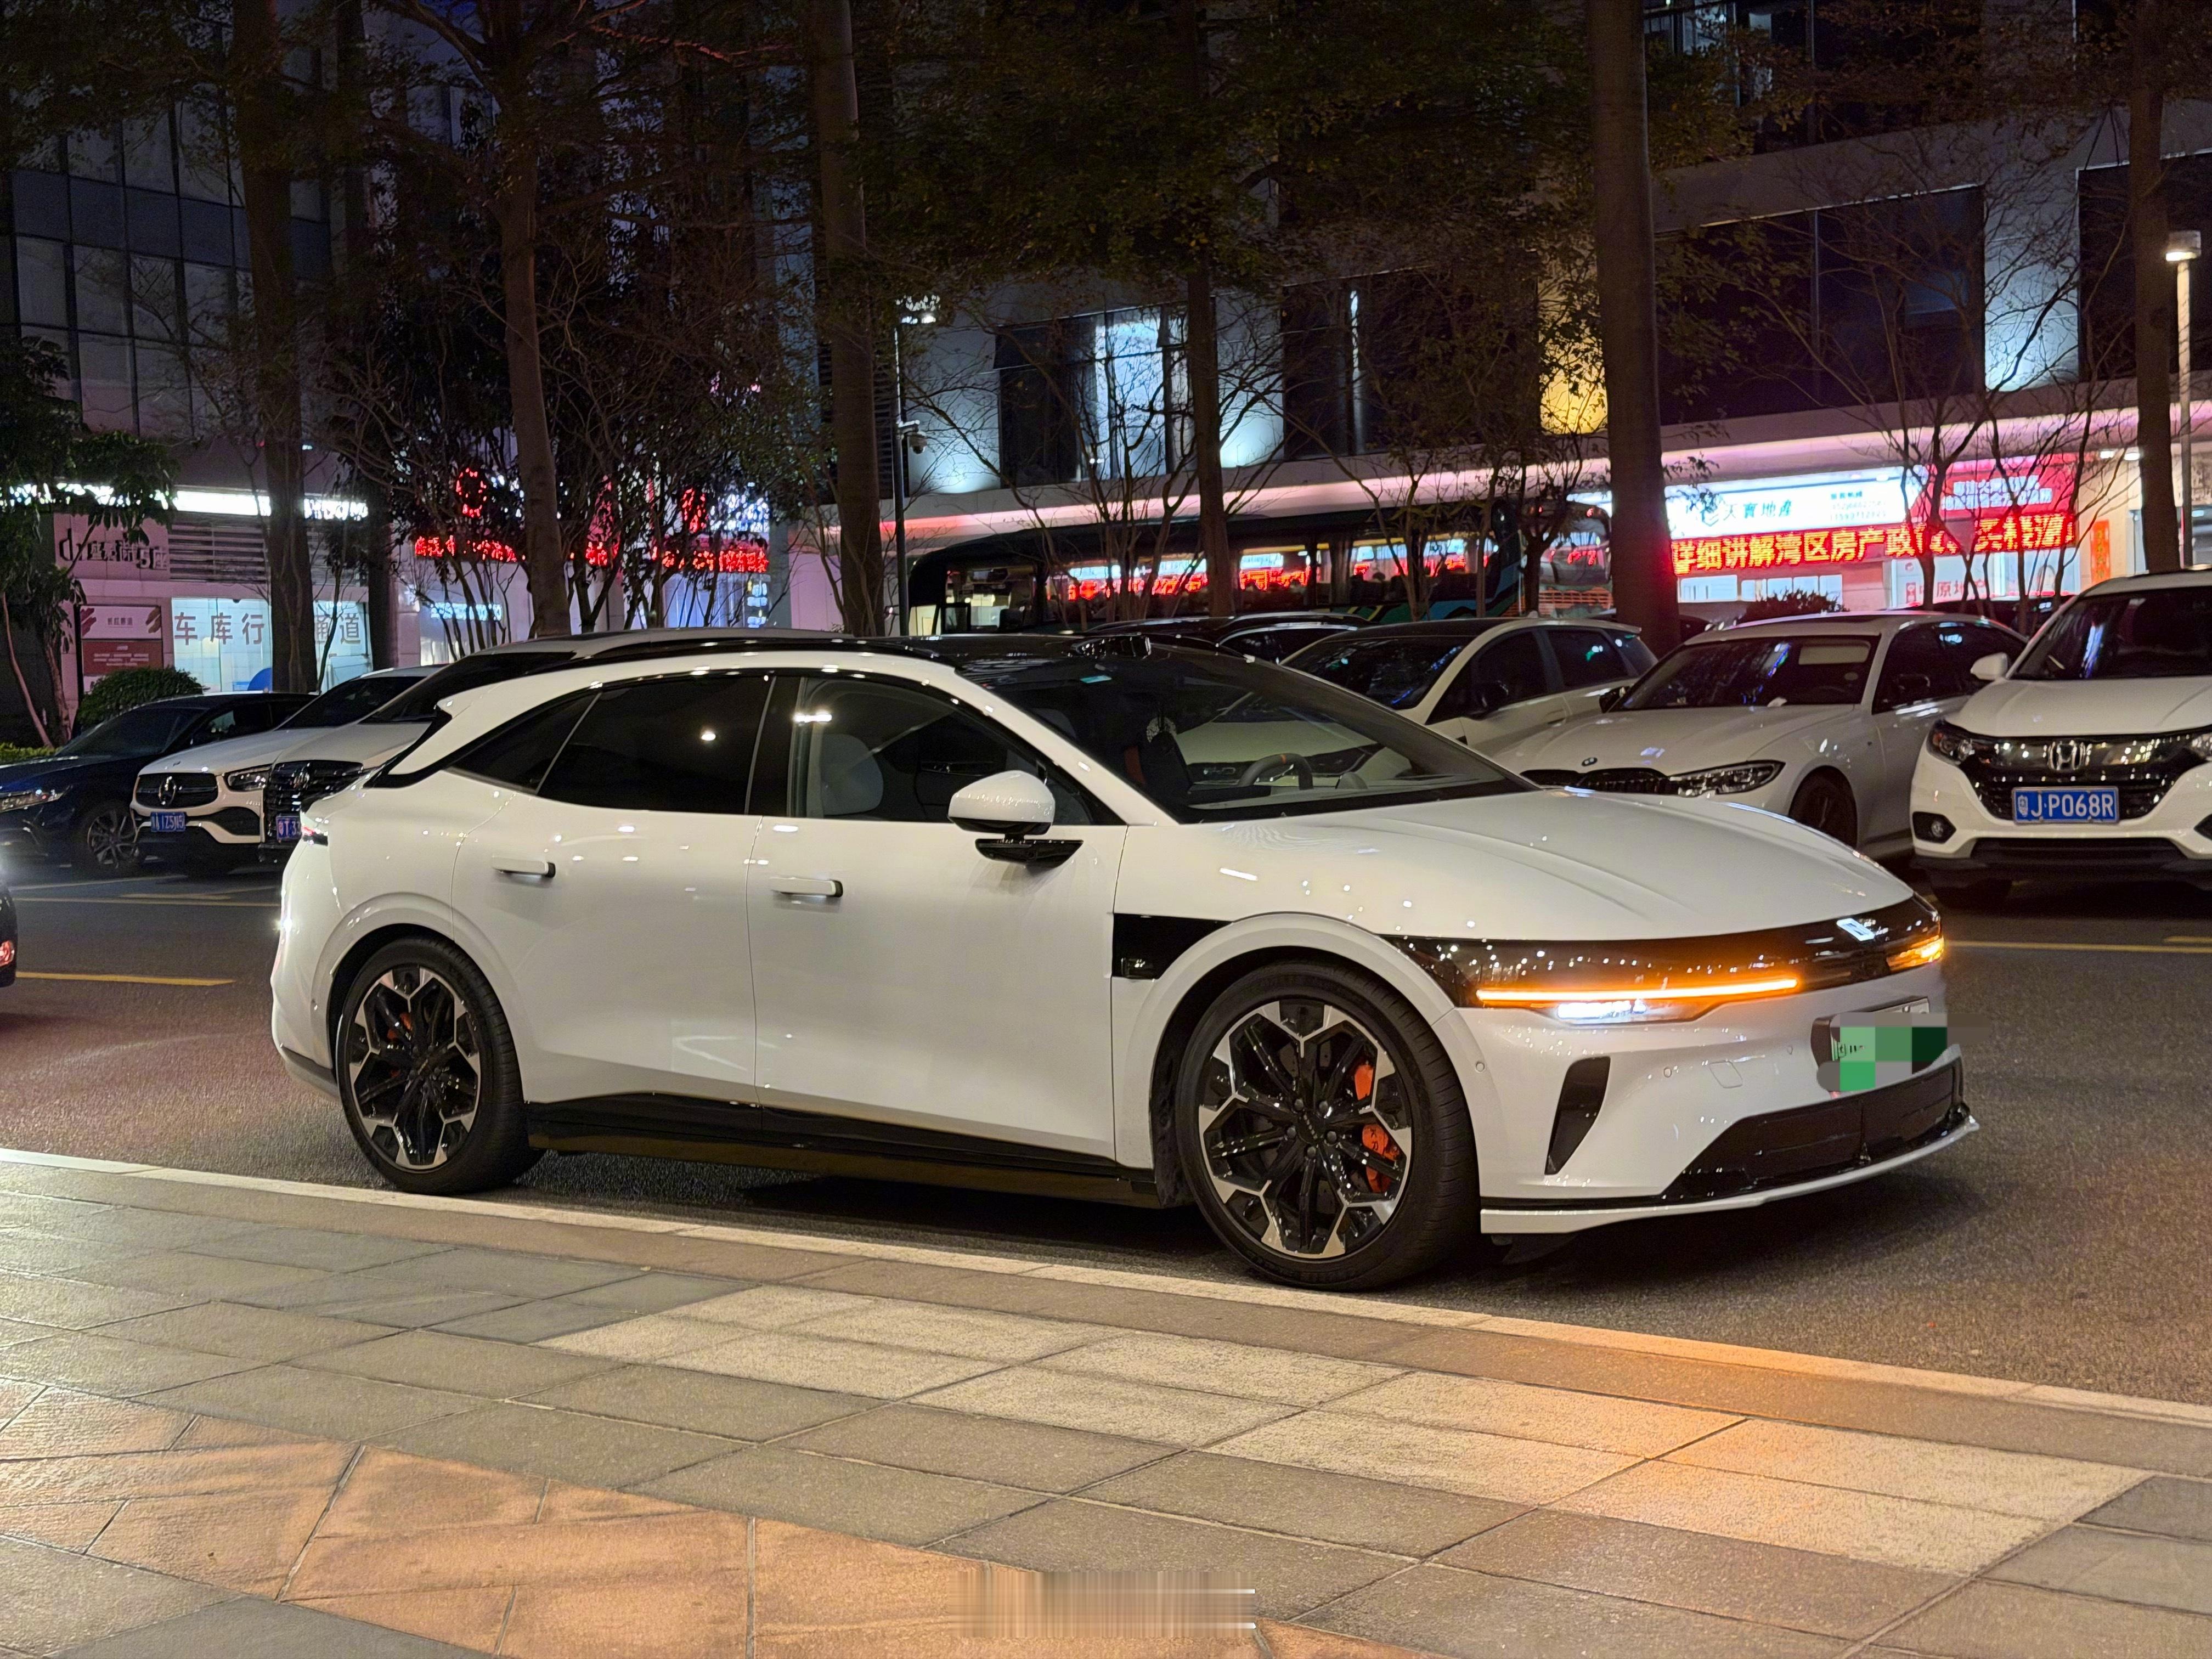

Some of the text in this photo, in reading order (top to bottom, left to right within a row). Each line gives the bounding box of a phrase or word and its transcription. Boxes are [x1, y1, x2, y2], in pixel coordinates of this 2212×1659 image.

[174, 612, 361, 646] 车库行通道
